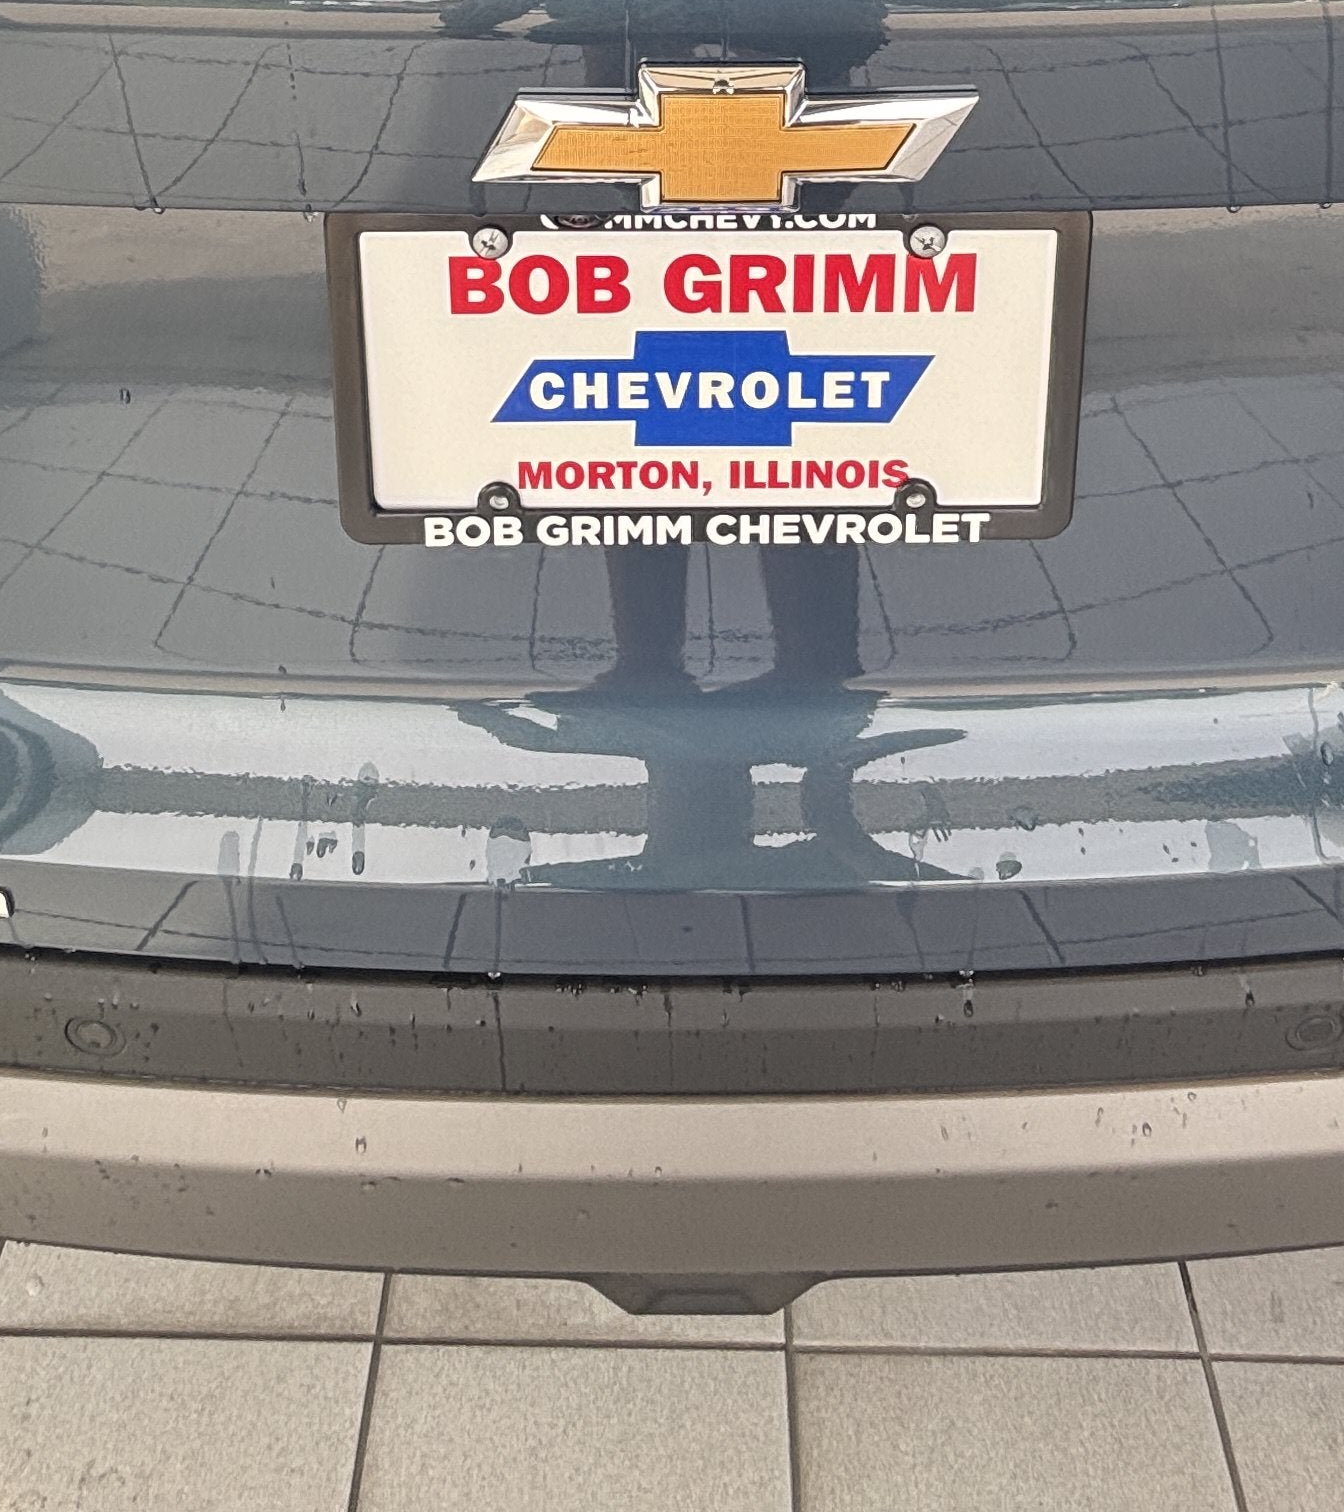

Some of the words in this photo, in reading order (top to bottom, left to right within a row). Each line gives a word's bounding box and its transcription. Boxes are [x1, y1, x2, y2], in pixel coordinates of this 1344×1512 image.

[448, 254, 631, 315] BOB
[663, 253, 978, 314] GRIMM
[528, 370, 891, 410] CHEVROLET
[517, 460, 713, 496] MORTON,
[728, 459, 910, 490] ILLINOIS
[423, 516, 525, 548] BOB
[535, 515, 693, 547] GRIMM
[704, 512, 992, 546] CHEVROLET
